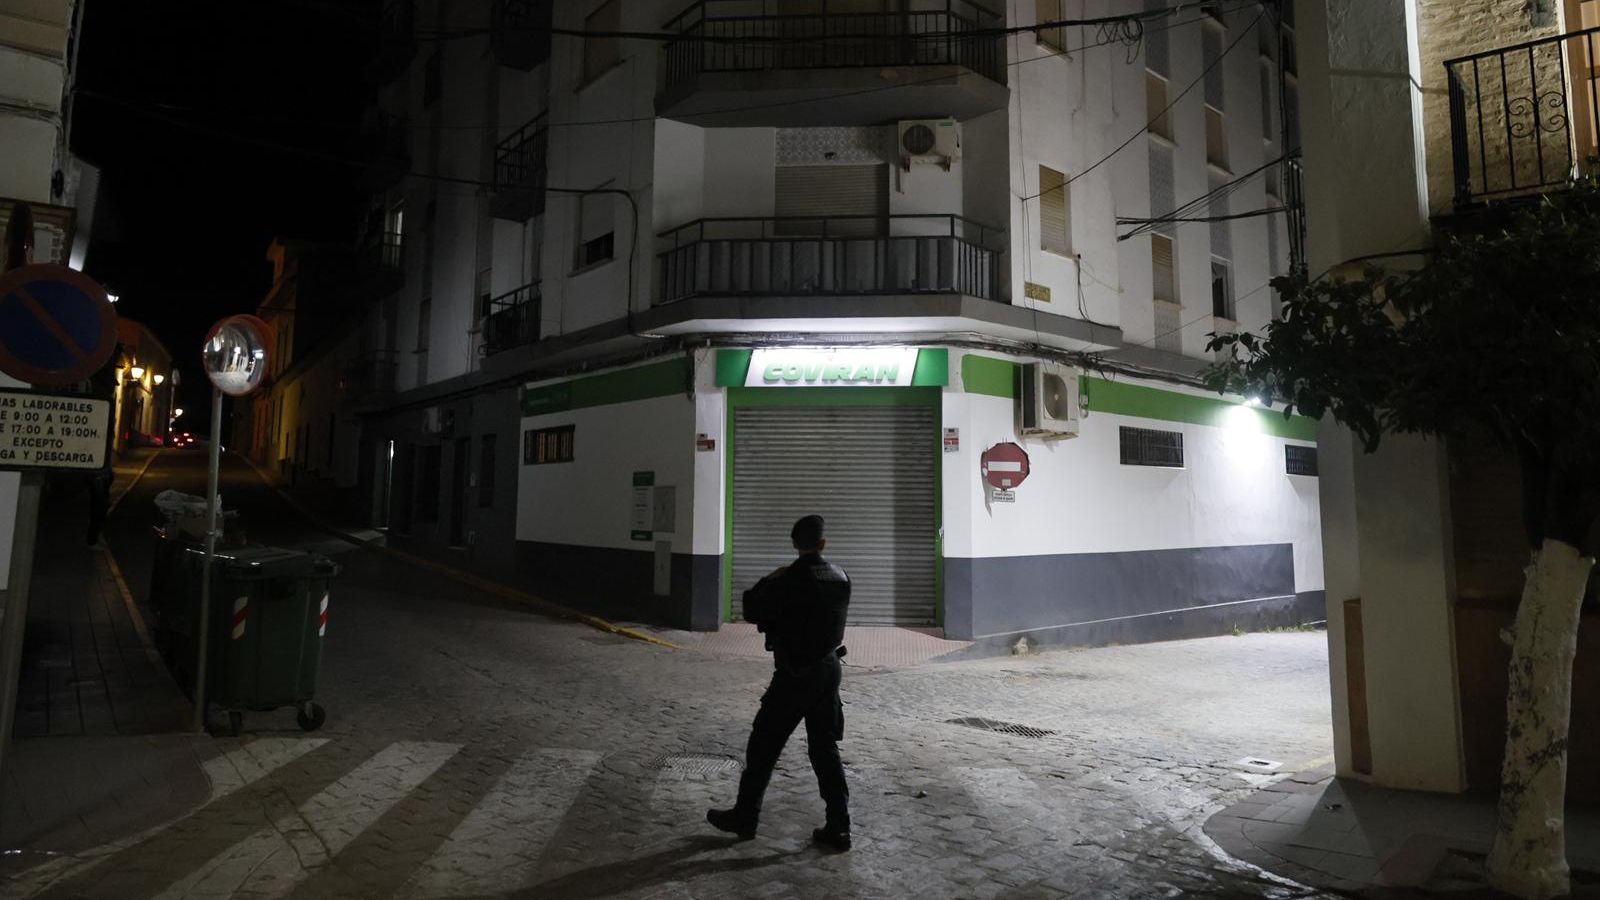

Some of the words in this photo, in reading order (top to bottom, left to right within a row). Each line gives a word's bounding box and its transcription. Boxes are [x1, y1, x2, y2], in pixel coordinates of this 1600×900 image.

[23, 399, 93, 413] LABORABLES
[14, 411, 39, 422] 9:00
[45, 413, 53, 422] A
[60, 415, 89, 425] 12:00
[12, 424, 41, 435] 17:00
[47, 426, 54, 435] A
[13, 437, 64, 449] EXCEPTO
[24, 450, 30, 460] Y
[36, 451, 94, 463] DESCARGA
